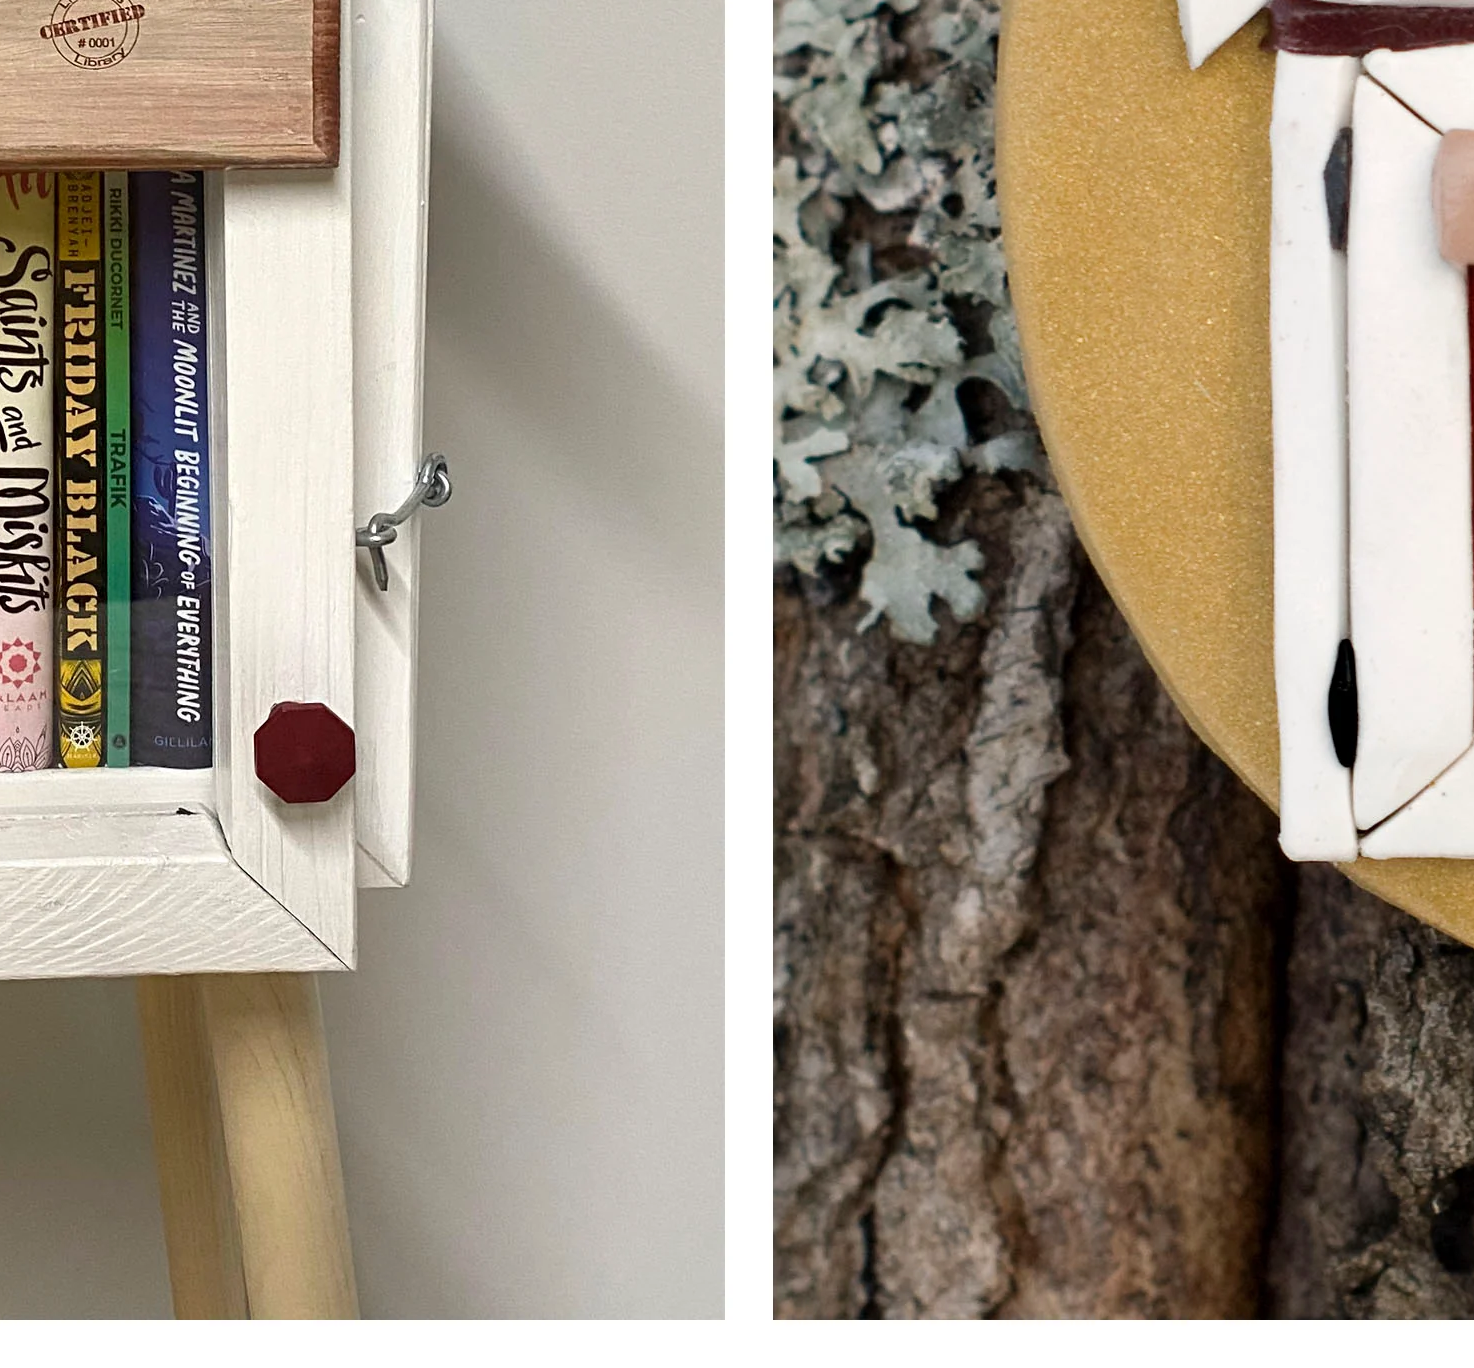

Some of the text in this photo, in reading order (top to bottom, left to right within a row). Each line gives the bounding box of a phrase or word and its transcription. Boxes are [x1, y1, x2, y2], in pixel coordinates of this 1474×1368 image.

[39, 4, 145, 40] CERTIFIED
[74, 47, 127, 67] Library
[88, 37, 116, 48] 0001
[67, 183, 79, 258] BRENYAH
[170, 171, 199, 297] A MARTINEZ
[108, 188, 124, 331] RIKKI DUCORNET
[186, 301, 201, 335] AND
[63, 268, 99, 653] FRIDAY BLACK
[109, 428, 127, 509] TRAFIK
[170, 299, 203, 723] THE MOONLIT BEGINNING OF EVERYTHING
[154, 735, 212, 748] GILLILA
